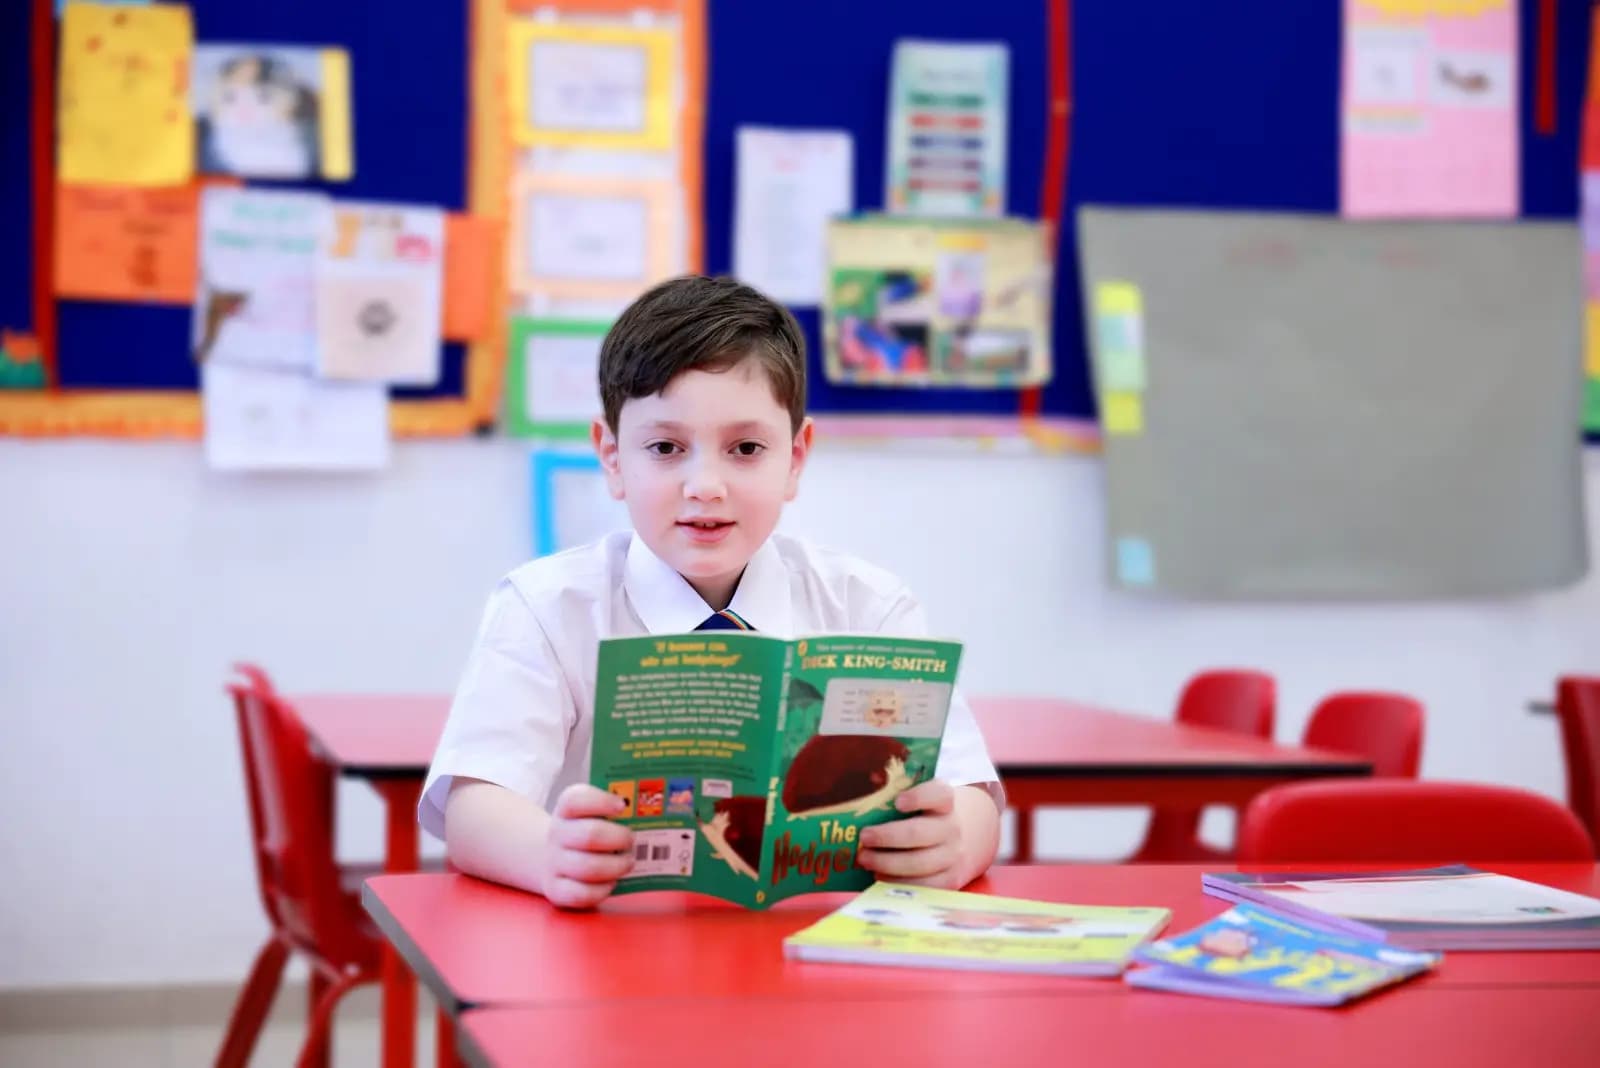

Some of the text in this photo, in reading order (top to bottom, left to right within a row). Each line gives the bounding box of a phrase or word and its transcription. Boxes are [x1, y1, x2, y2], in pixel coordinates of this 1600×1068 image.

[843, 654, 947, 673] KING-SMITH
[820, 820, 857, 844] The
[772, 830, 863, 886] Hodge
